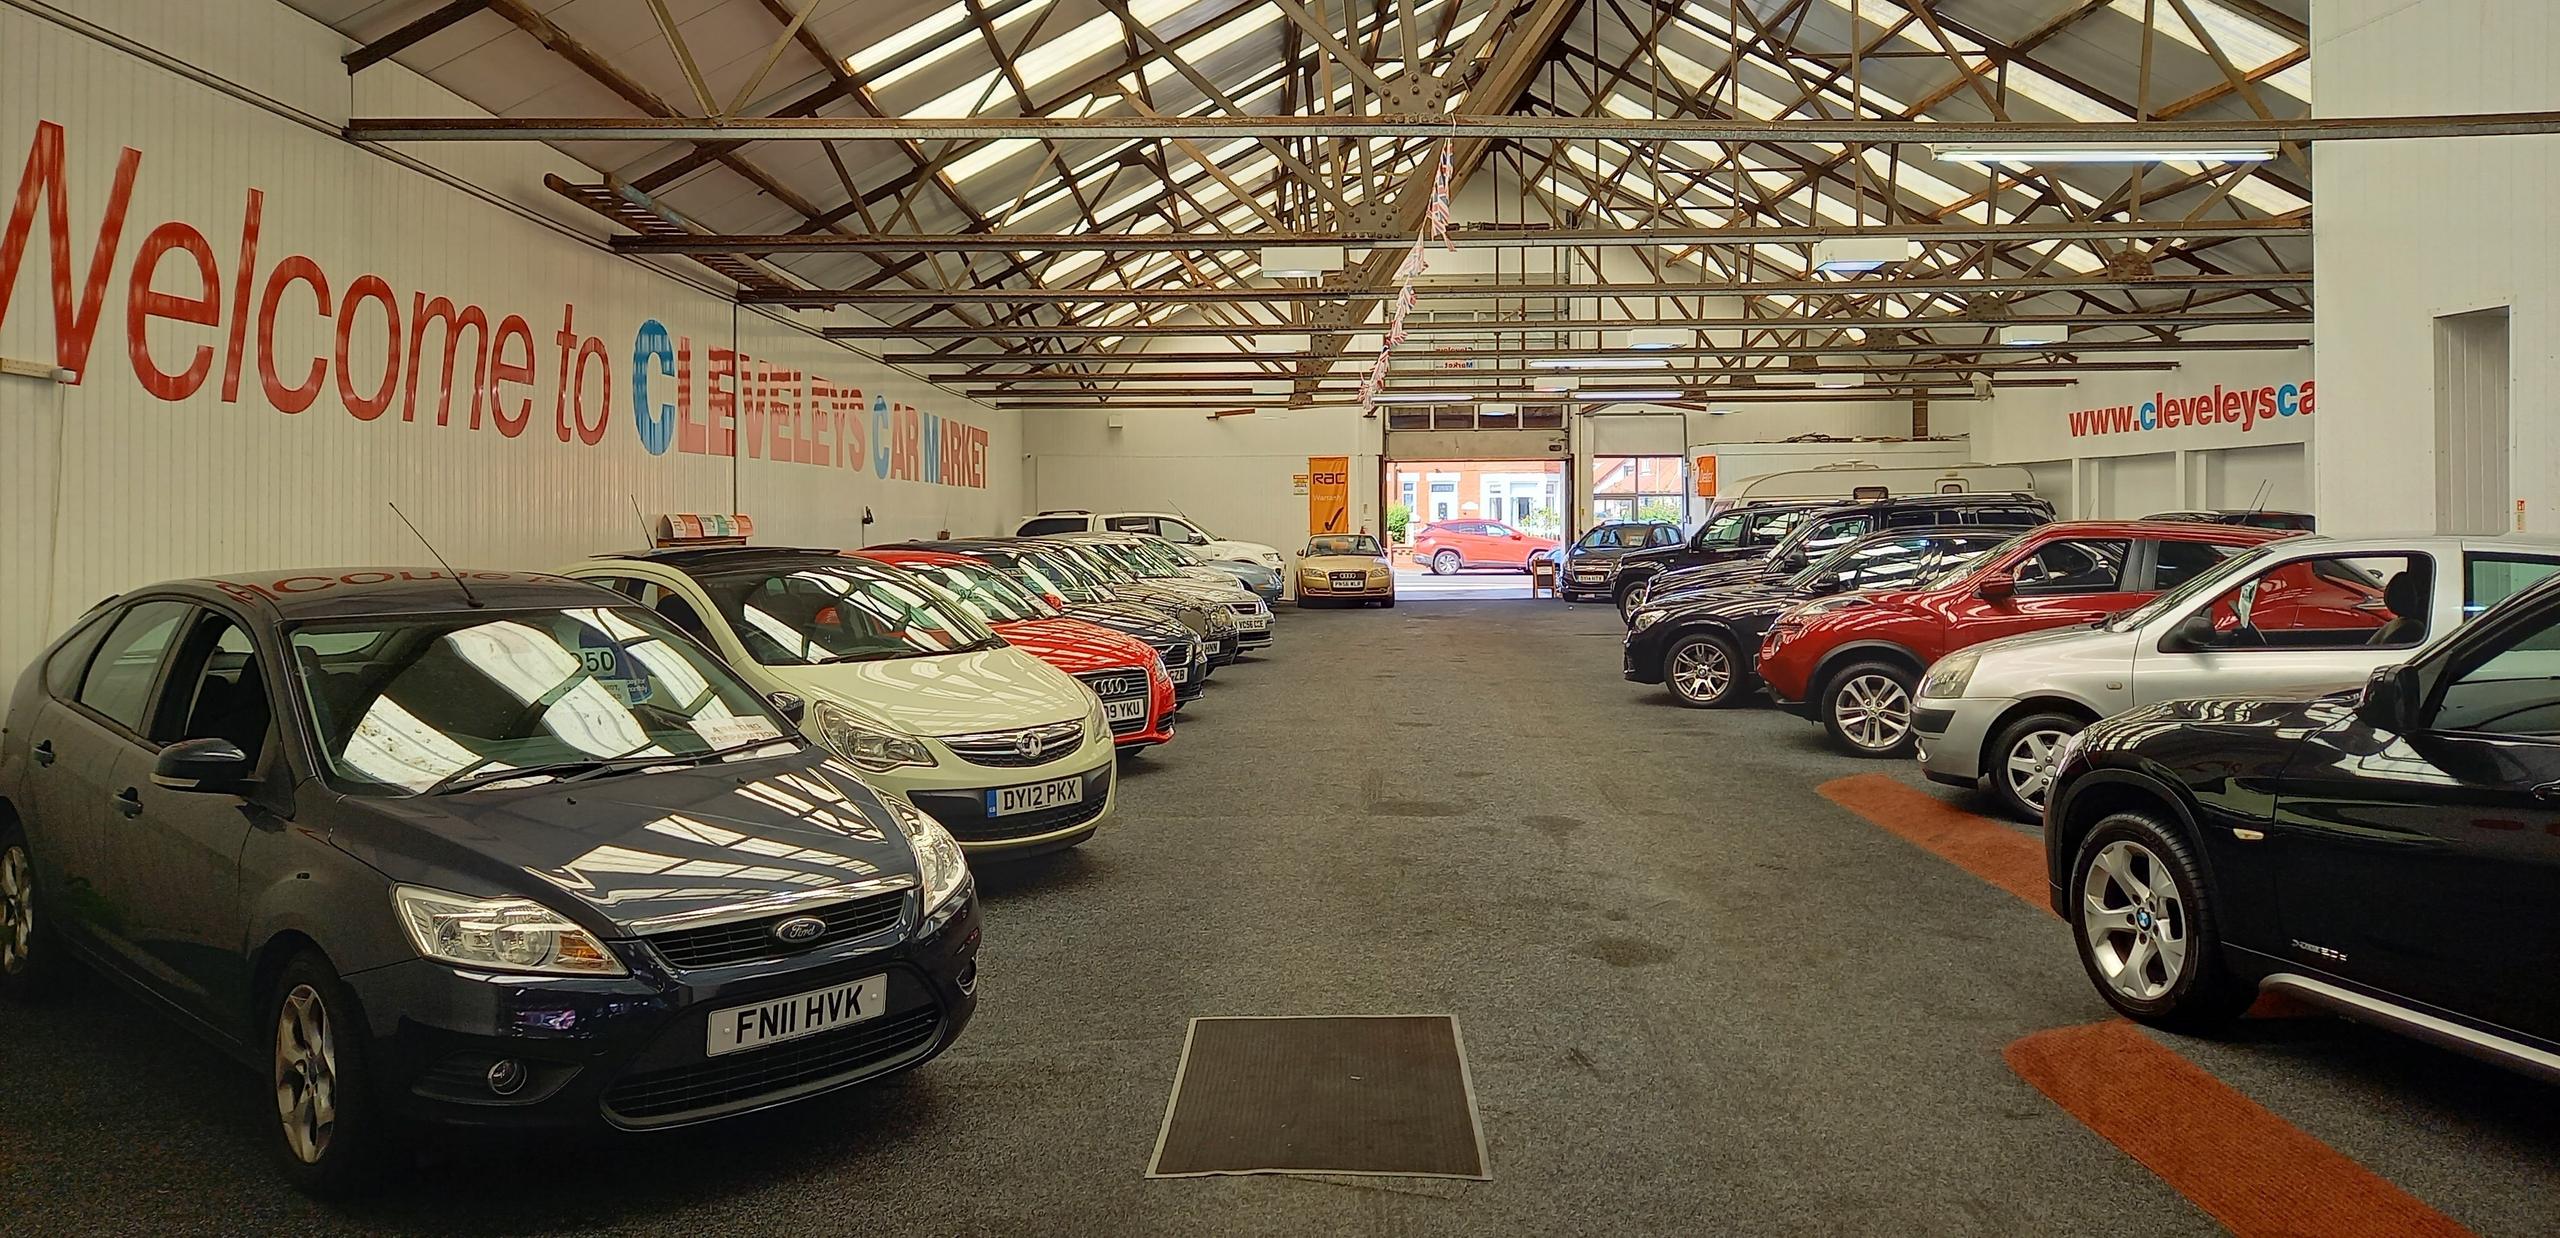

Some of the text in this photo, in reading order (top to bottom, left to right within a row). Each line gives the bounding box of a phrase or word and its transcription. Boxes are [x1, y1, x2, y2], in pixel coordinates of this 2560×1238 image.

[0, 120, 989, 489] Welcome to CLEVELEYS CAR MARKET
[1119, 701, 1140, 717] YKU
[1004, 780, 1077, 811] DY12 PKX
[789, 922, 817, 939] Ford
[736, 1000, 797, 1044] FN11
[805, 984, 863, 1029] HVK
